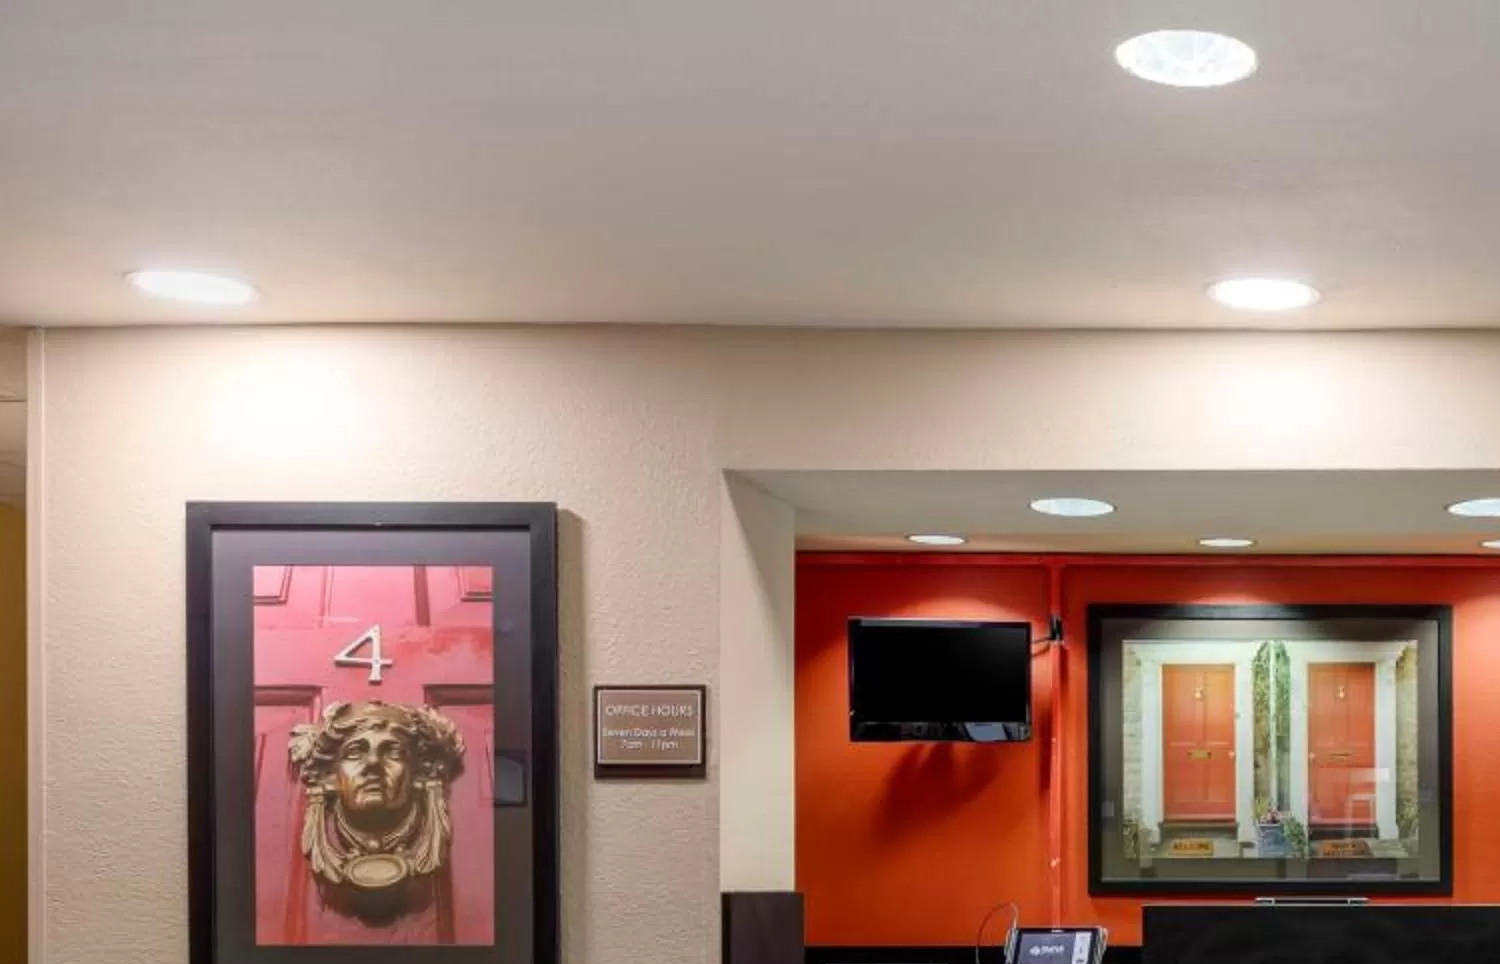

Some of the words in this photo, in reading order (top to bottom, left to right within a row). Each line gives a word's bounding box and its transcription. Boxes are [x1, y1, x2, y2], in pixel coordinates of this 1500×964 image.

[333, 623, 393, 682] 4
[605, 704, 650, 717] OFFICE
[651, 704, 694, 717] HOURS
